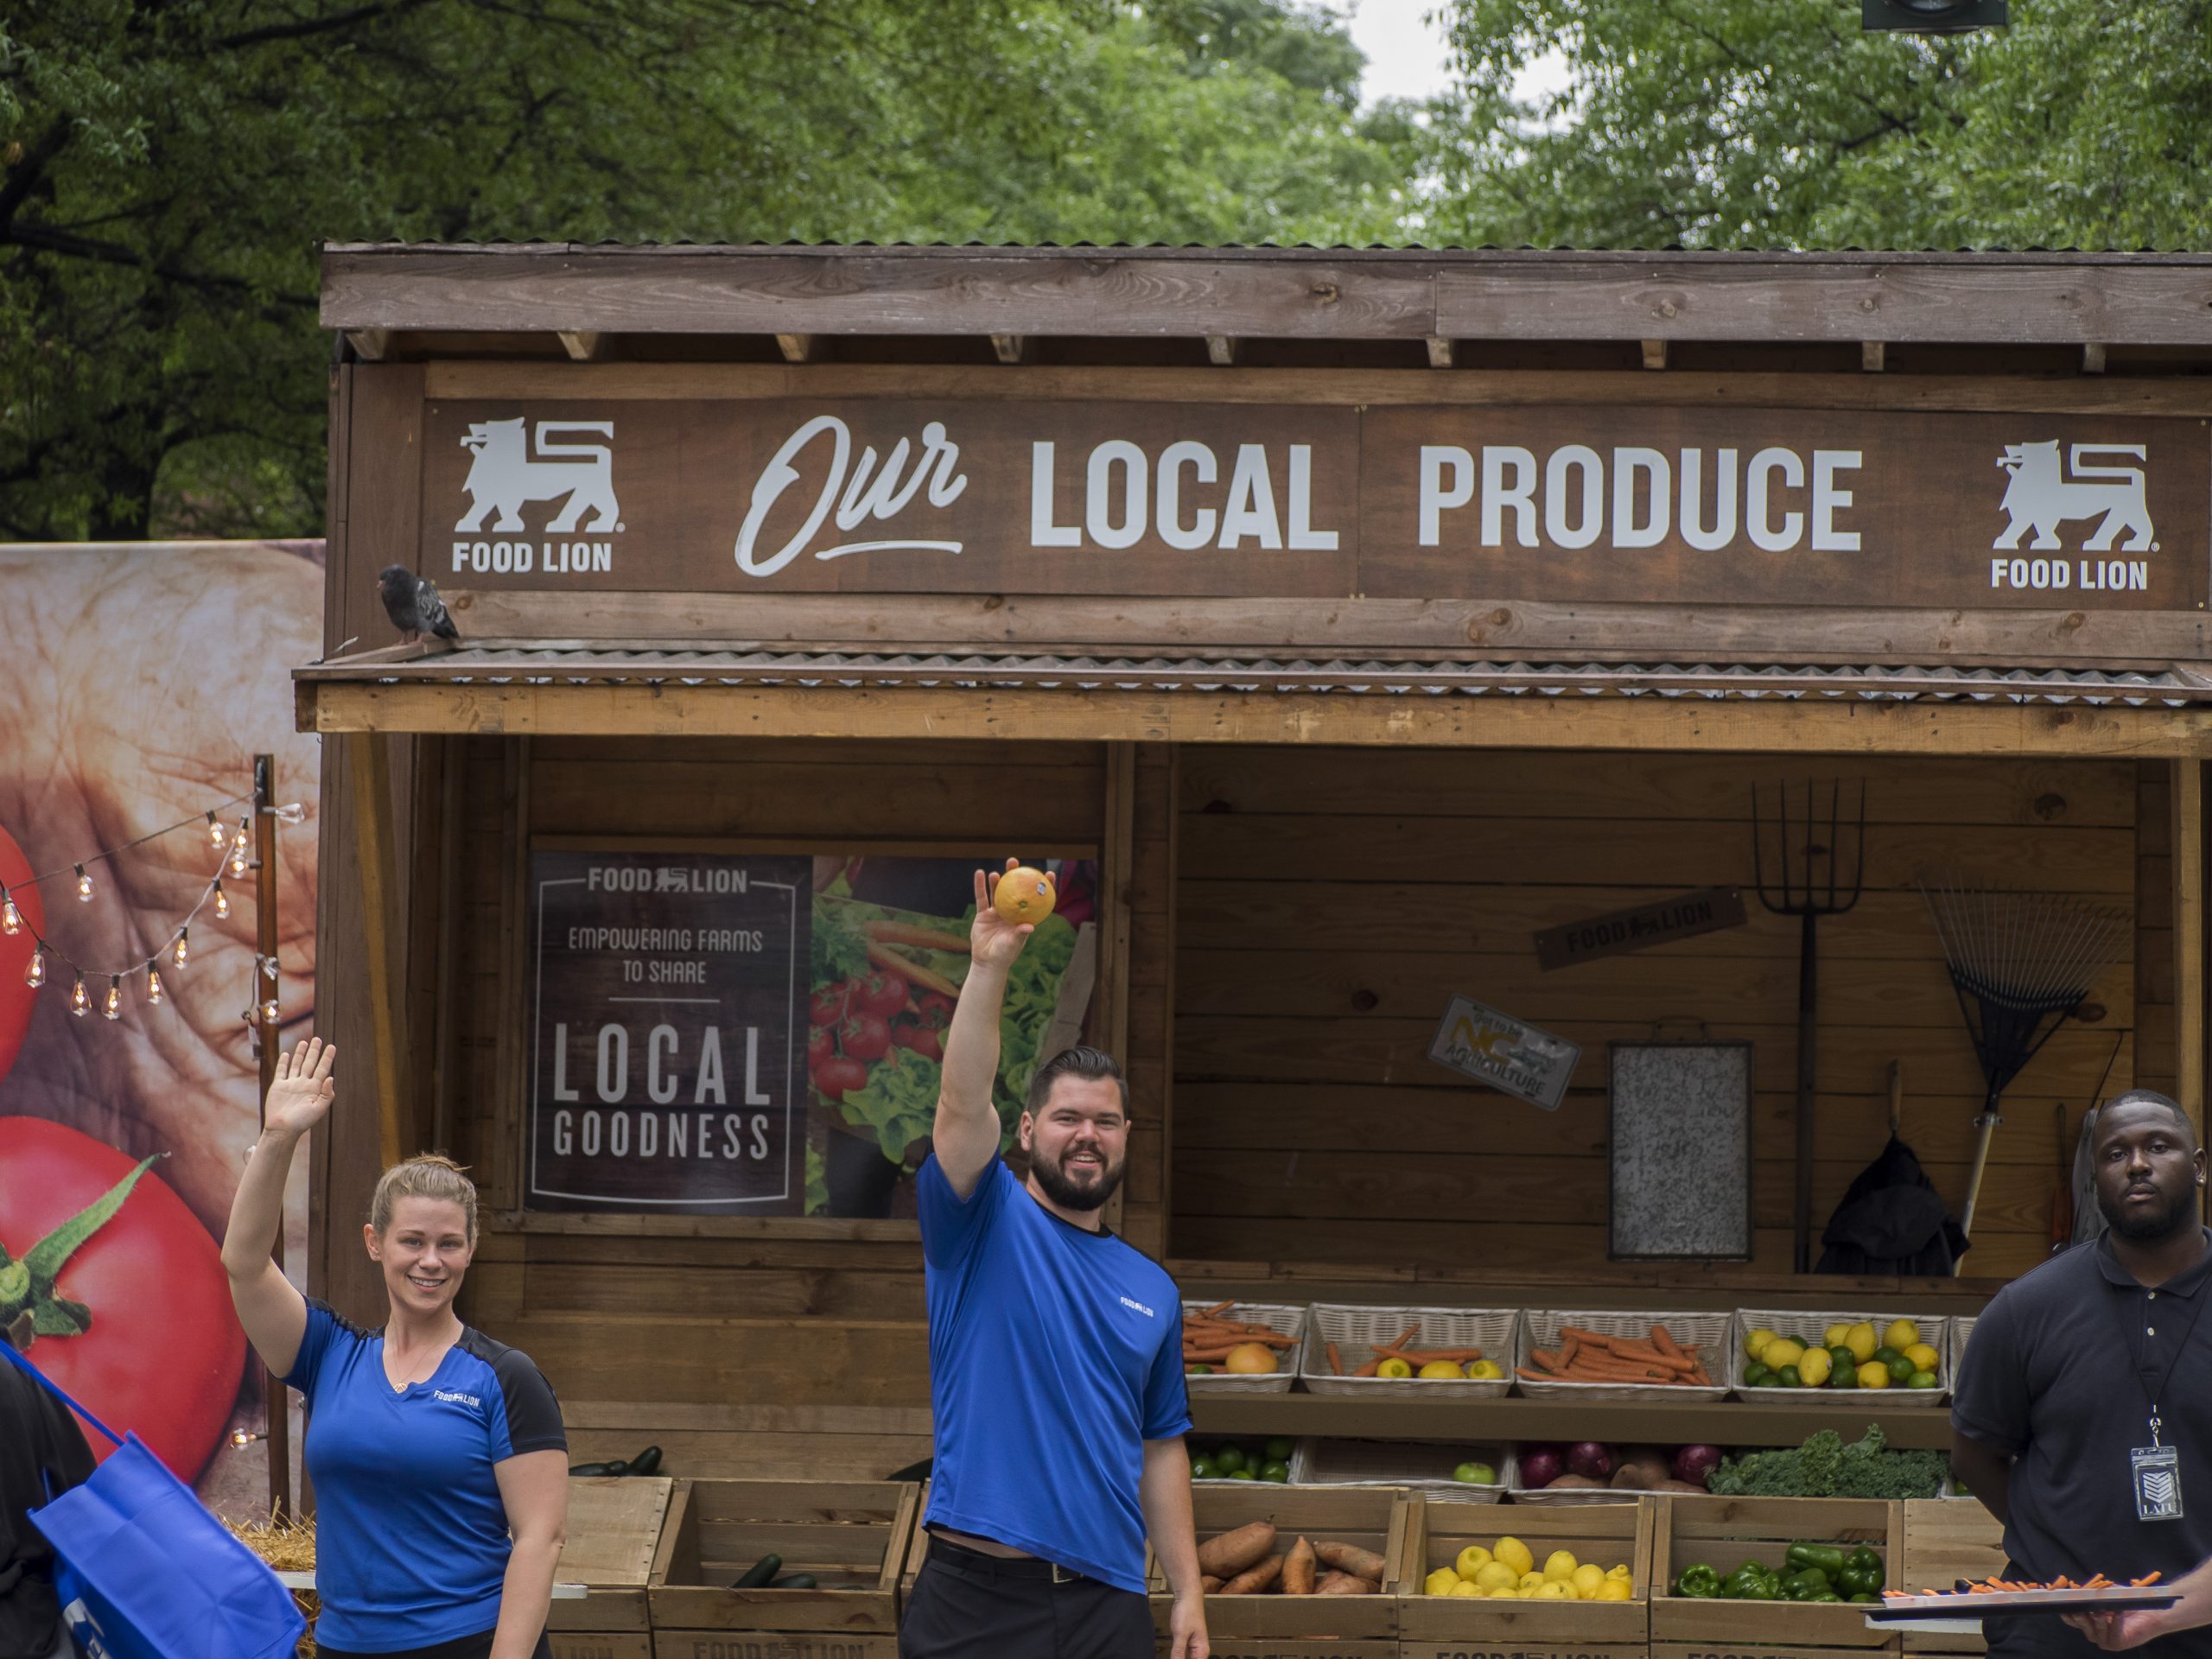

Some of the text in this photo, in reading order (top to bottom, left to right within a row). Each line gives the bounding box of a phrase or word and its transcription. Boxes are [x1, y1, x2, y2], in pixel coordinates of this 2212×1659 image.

[734, 415, 1862, 577] Our LOCAL PRODUCE
[452, 542, 612, 574] FOOD LION
[1991, 558, 2147, 590] FOOD LION
[588, 867, 747, 893] FOOD LION
[569, 926, 763, 952] EMPOWERING FARMS
[1566, 900, 1714, 954] FOOD LION
[623, 960, 706, 983] TO SHARE
[554, 1023, 771, 1105] LOCAL
[554, 1109, 769, 1160] GOODNESS
[434, 1389, 480, 1408] FOOD LION
